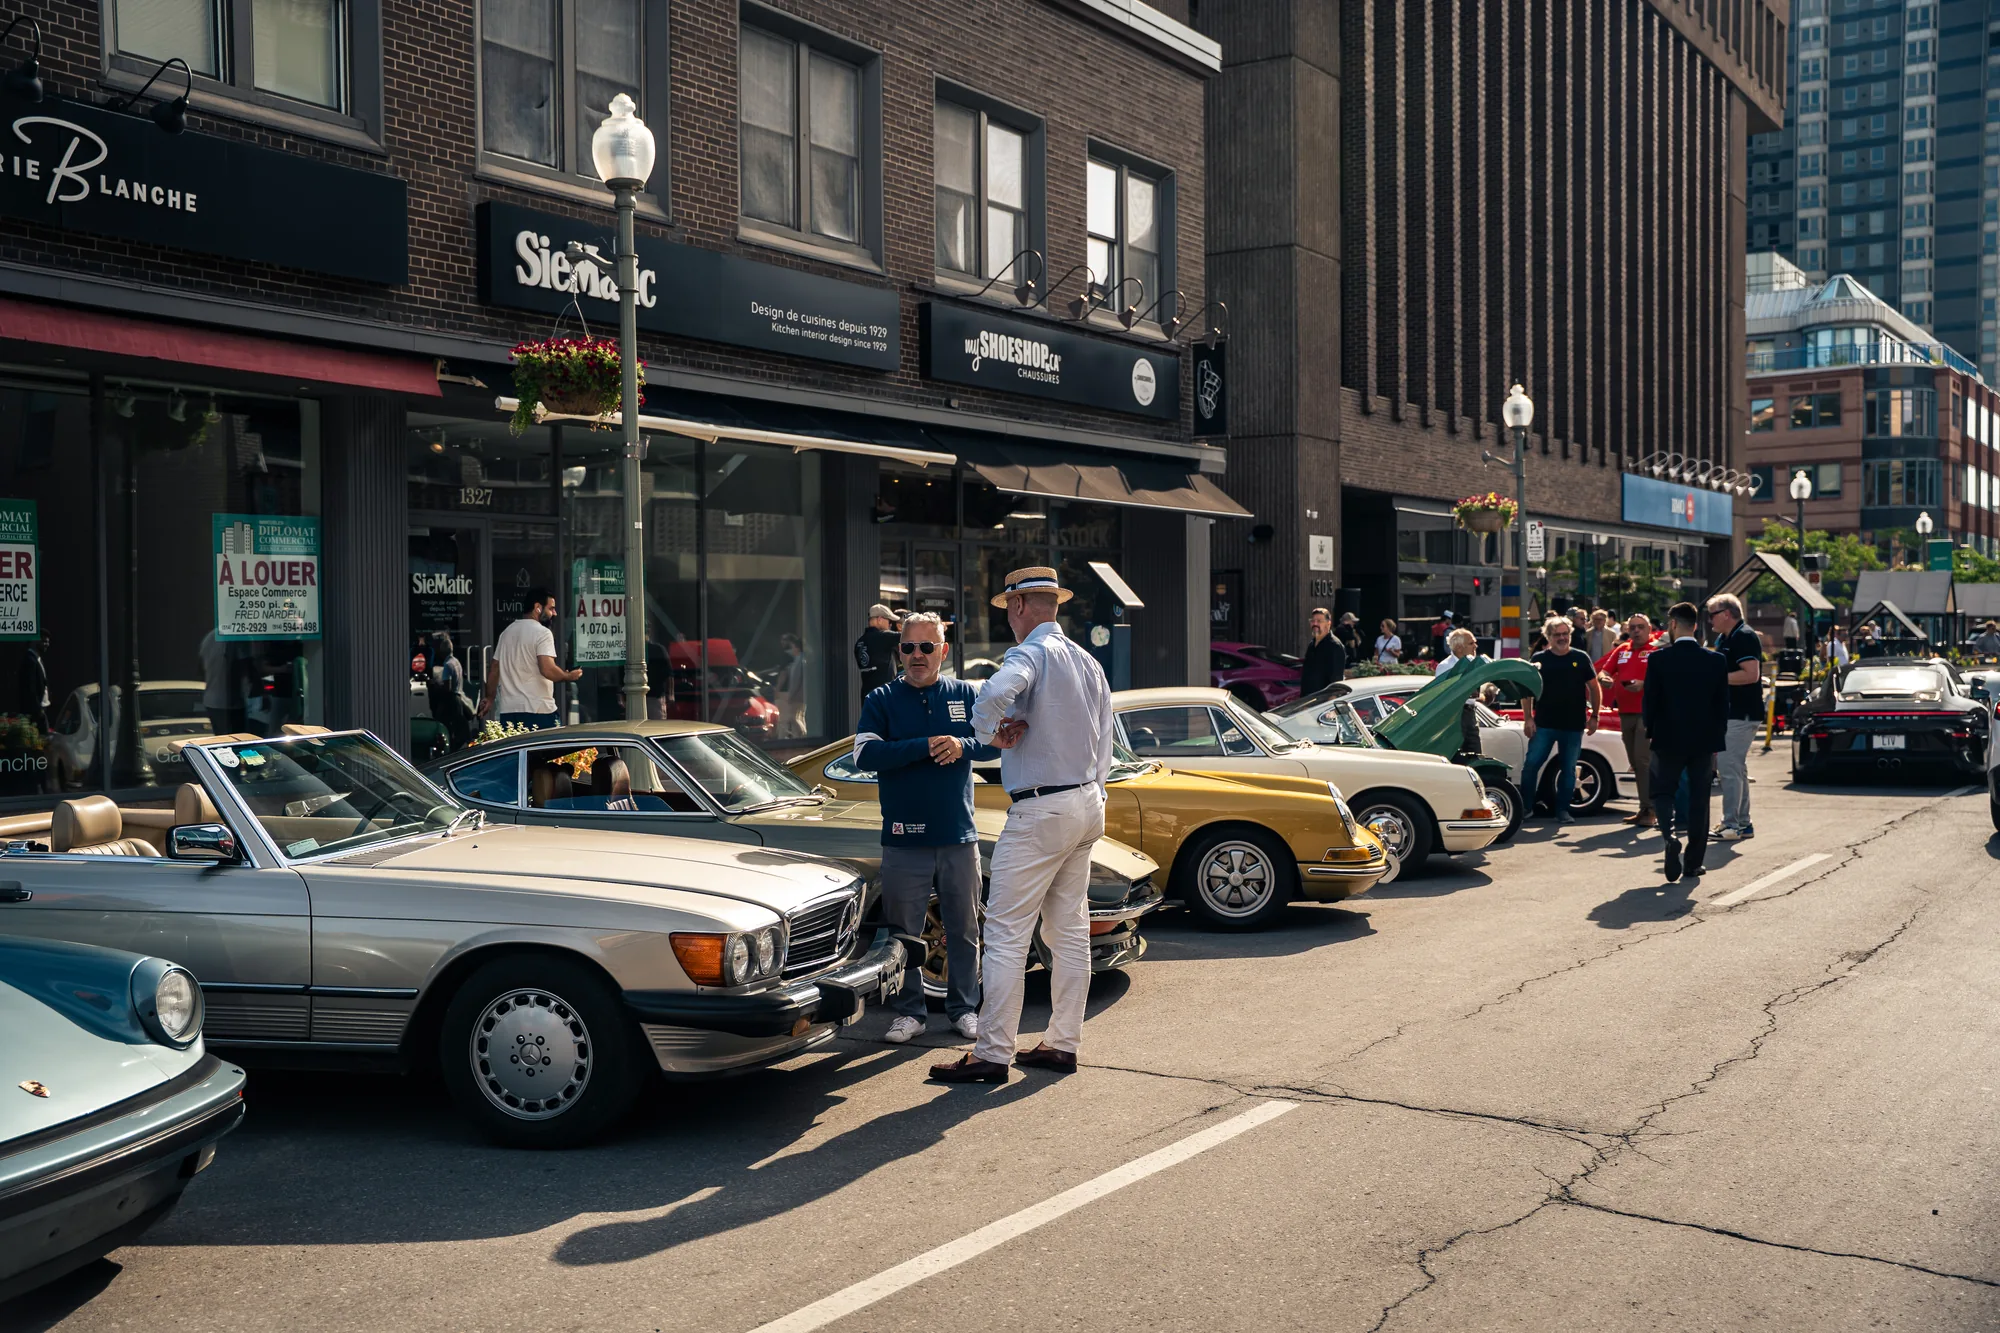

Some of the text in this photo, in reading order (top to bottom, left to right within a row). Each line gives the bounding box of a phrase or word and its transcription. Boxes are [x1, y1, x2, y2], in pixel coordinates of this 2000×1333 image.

[12, 116, 198, 213] BLANCHE
[515, 230, 657, 308] SieMac
[751, 301, 888, 338] Design de cuisines depuis 1929
[771, 322, 888, 352] Kitchen interior design since 1929
[1017, 367, 1060, 385] CHAUSSURES
[458, 487, 493, 506] 1327
[0, 511, 32, 523] MAT
[0, 523, 33, 533] RCIAL
[258, 525, 317, 538] DIPLOMAT
[258, 535, 317, 546] COMMERCIAL
[219, 554, 317, 586] À LOUER
[412, 572, 473, 595] SieMatic
[1311, 579, 1334, 597] 1303
[228, 586, 307, 599] Espace Commerce
[239, 600, 266, 609] 2,950
[268, 600, 281, 610] pi.
[496, 599, 524, 612] Livin
[577, 595, 626, 617] À LOU
[235, 610, 260, 620] FRED
[0, 620, 34, 632] 4-1498
[231, 622, 268, 632] 726-2929
[283, 622, 318, 632] 594-1498
[580, 623, 624, 637] 1,070 pi.
[587, 641, 605, 649] FRED
